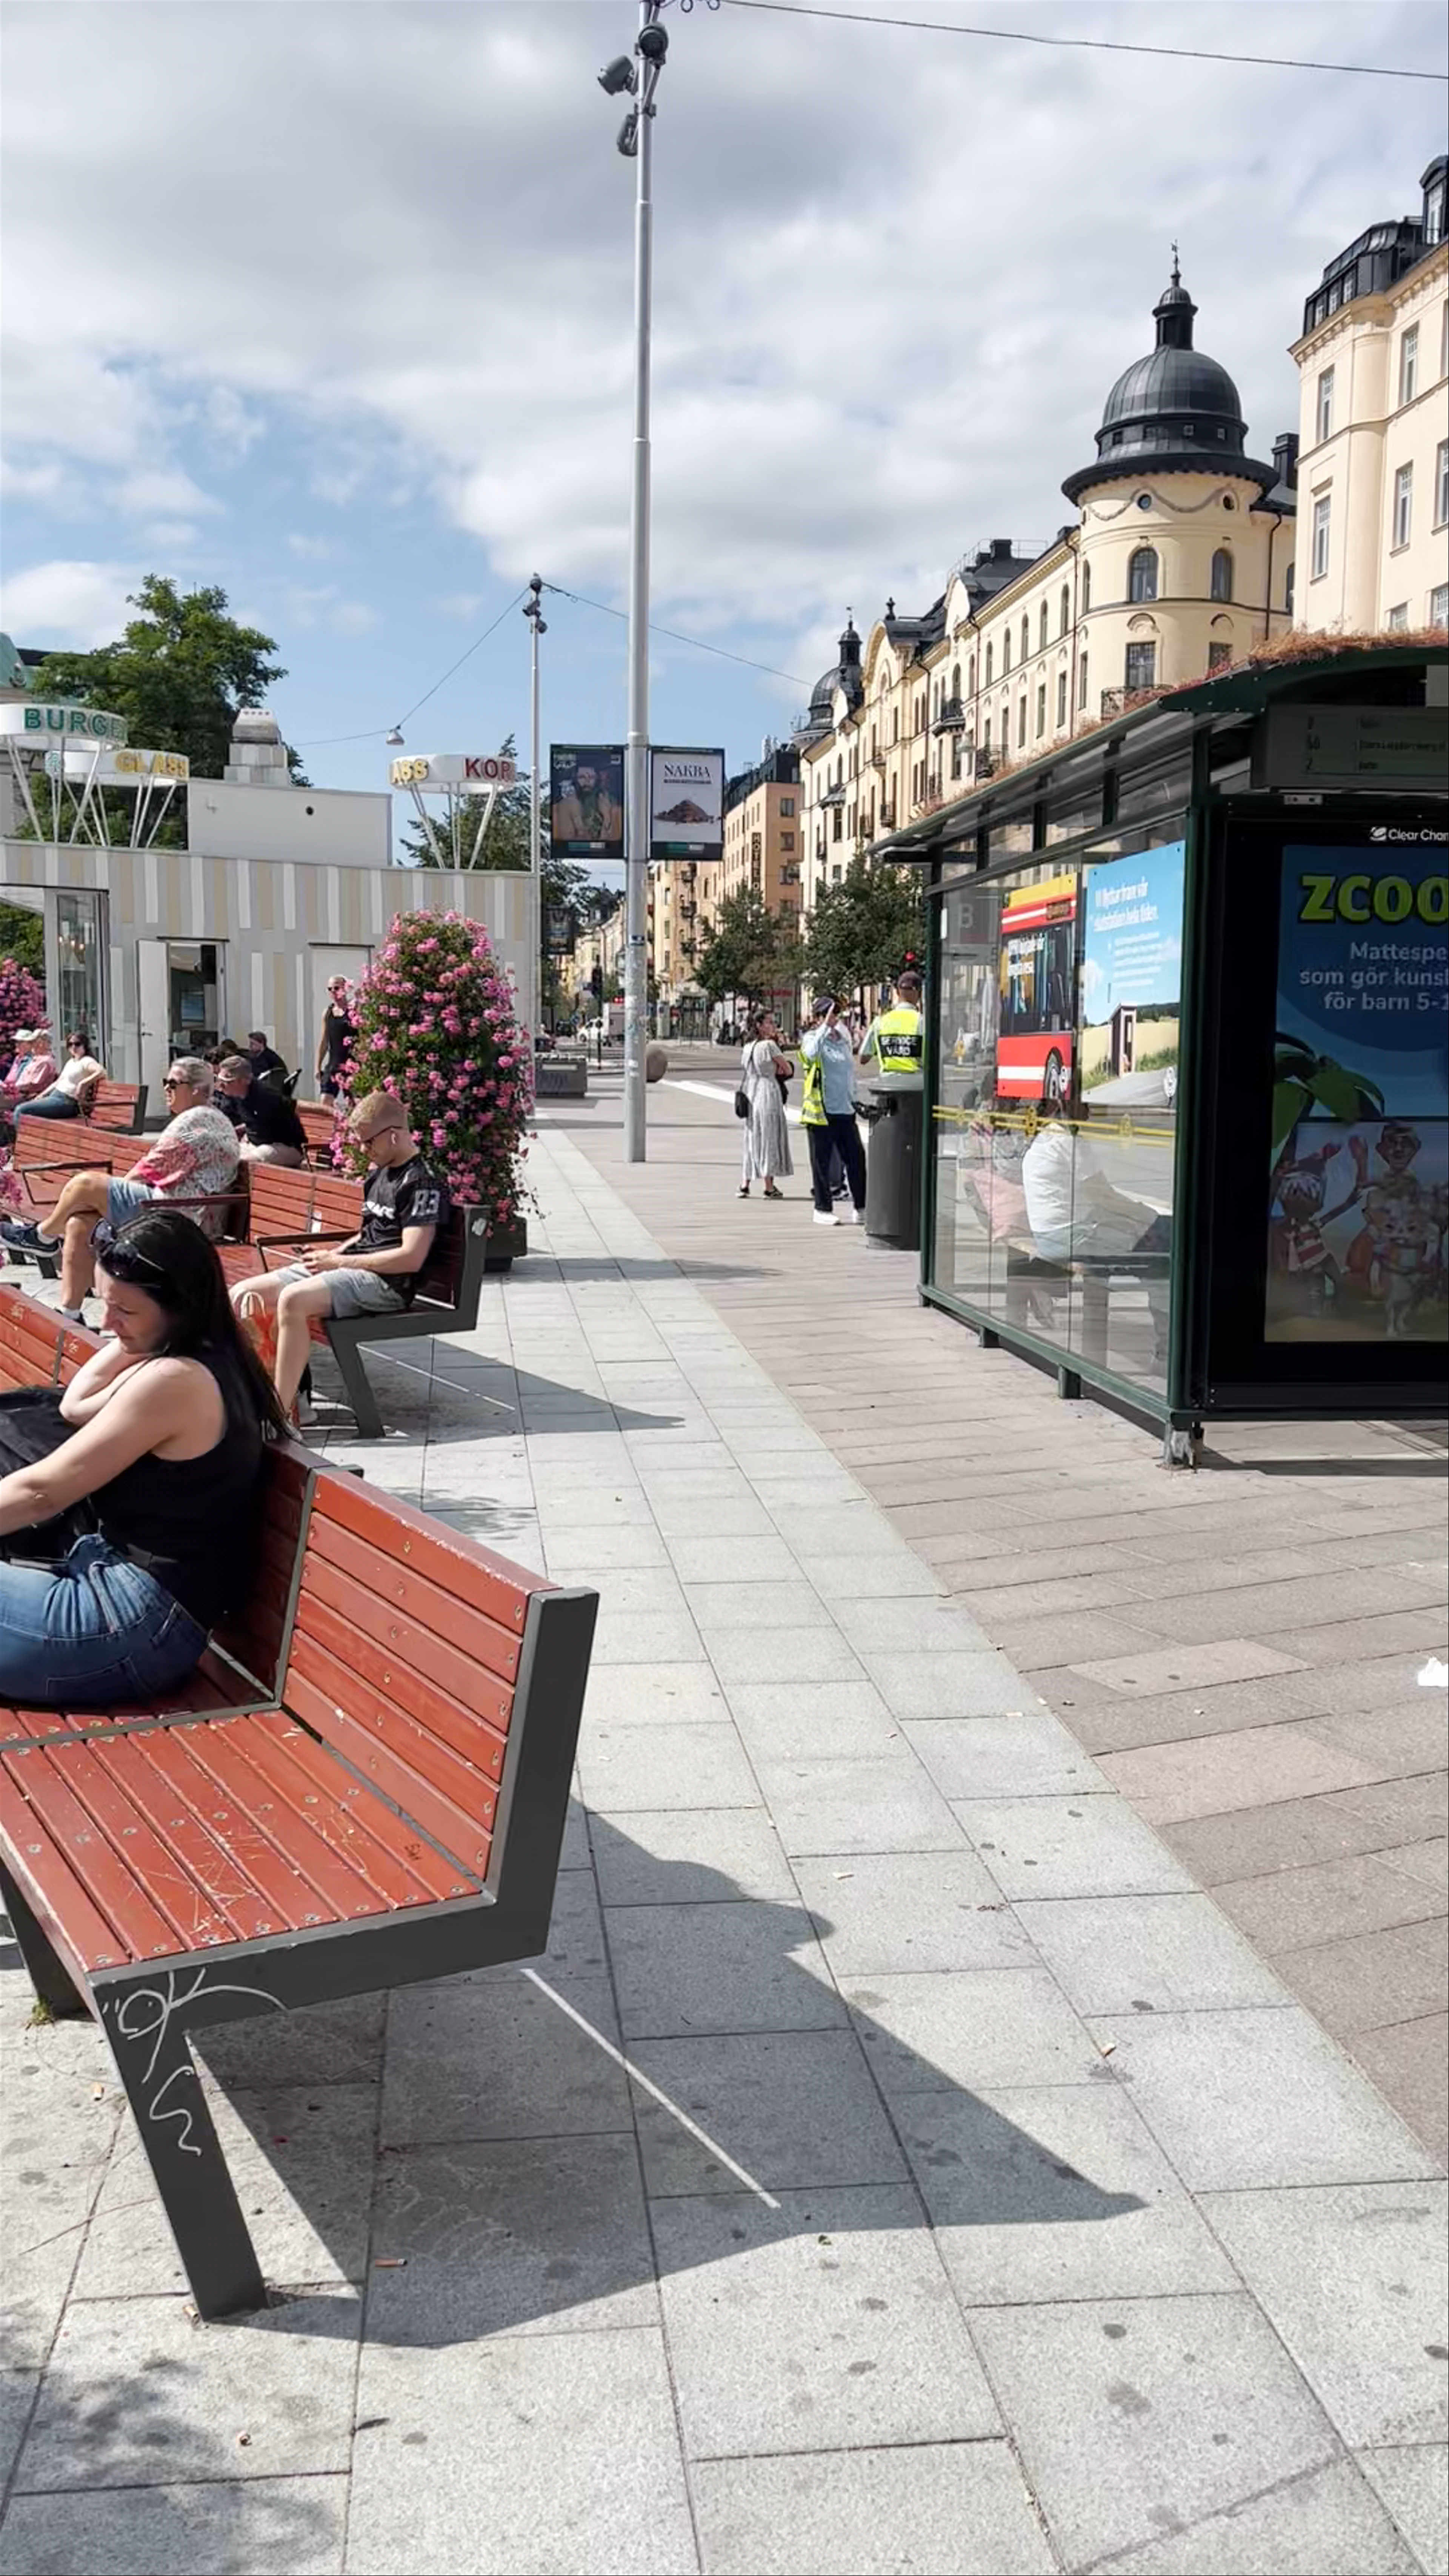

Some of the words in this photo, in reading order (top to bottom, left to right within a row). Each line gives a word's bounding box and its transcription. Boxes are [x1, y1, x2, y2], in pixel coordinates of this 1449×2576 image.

[663, 762, 711, 778] NAKBA
[1388, 827, 1418, 840] Clear
[1300, 875, 1449, 922] ZCOO
[1351, 942, 1447, 964] Mattespe
[1300, 971, 1344, 984] som
[1351, 966, 1389, 990] gör
[1324, 991, 1356, 1009] för
[1361, 992, 1409, 1010] barn
